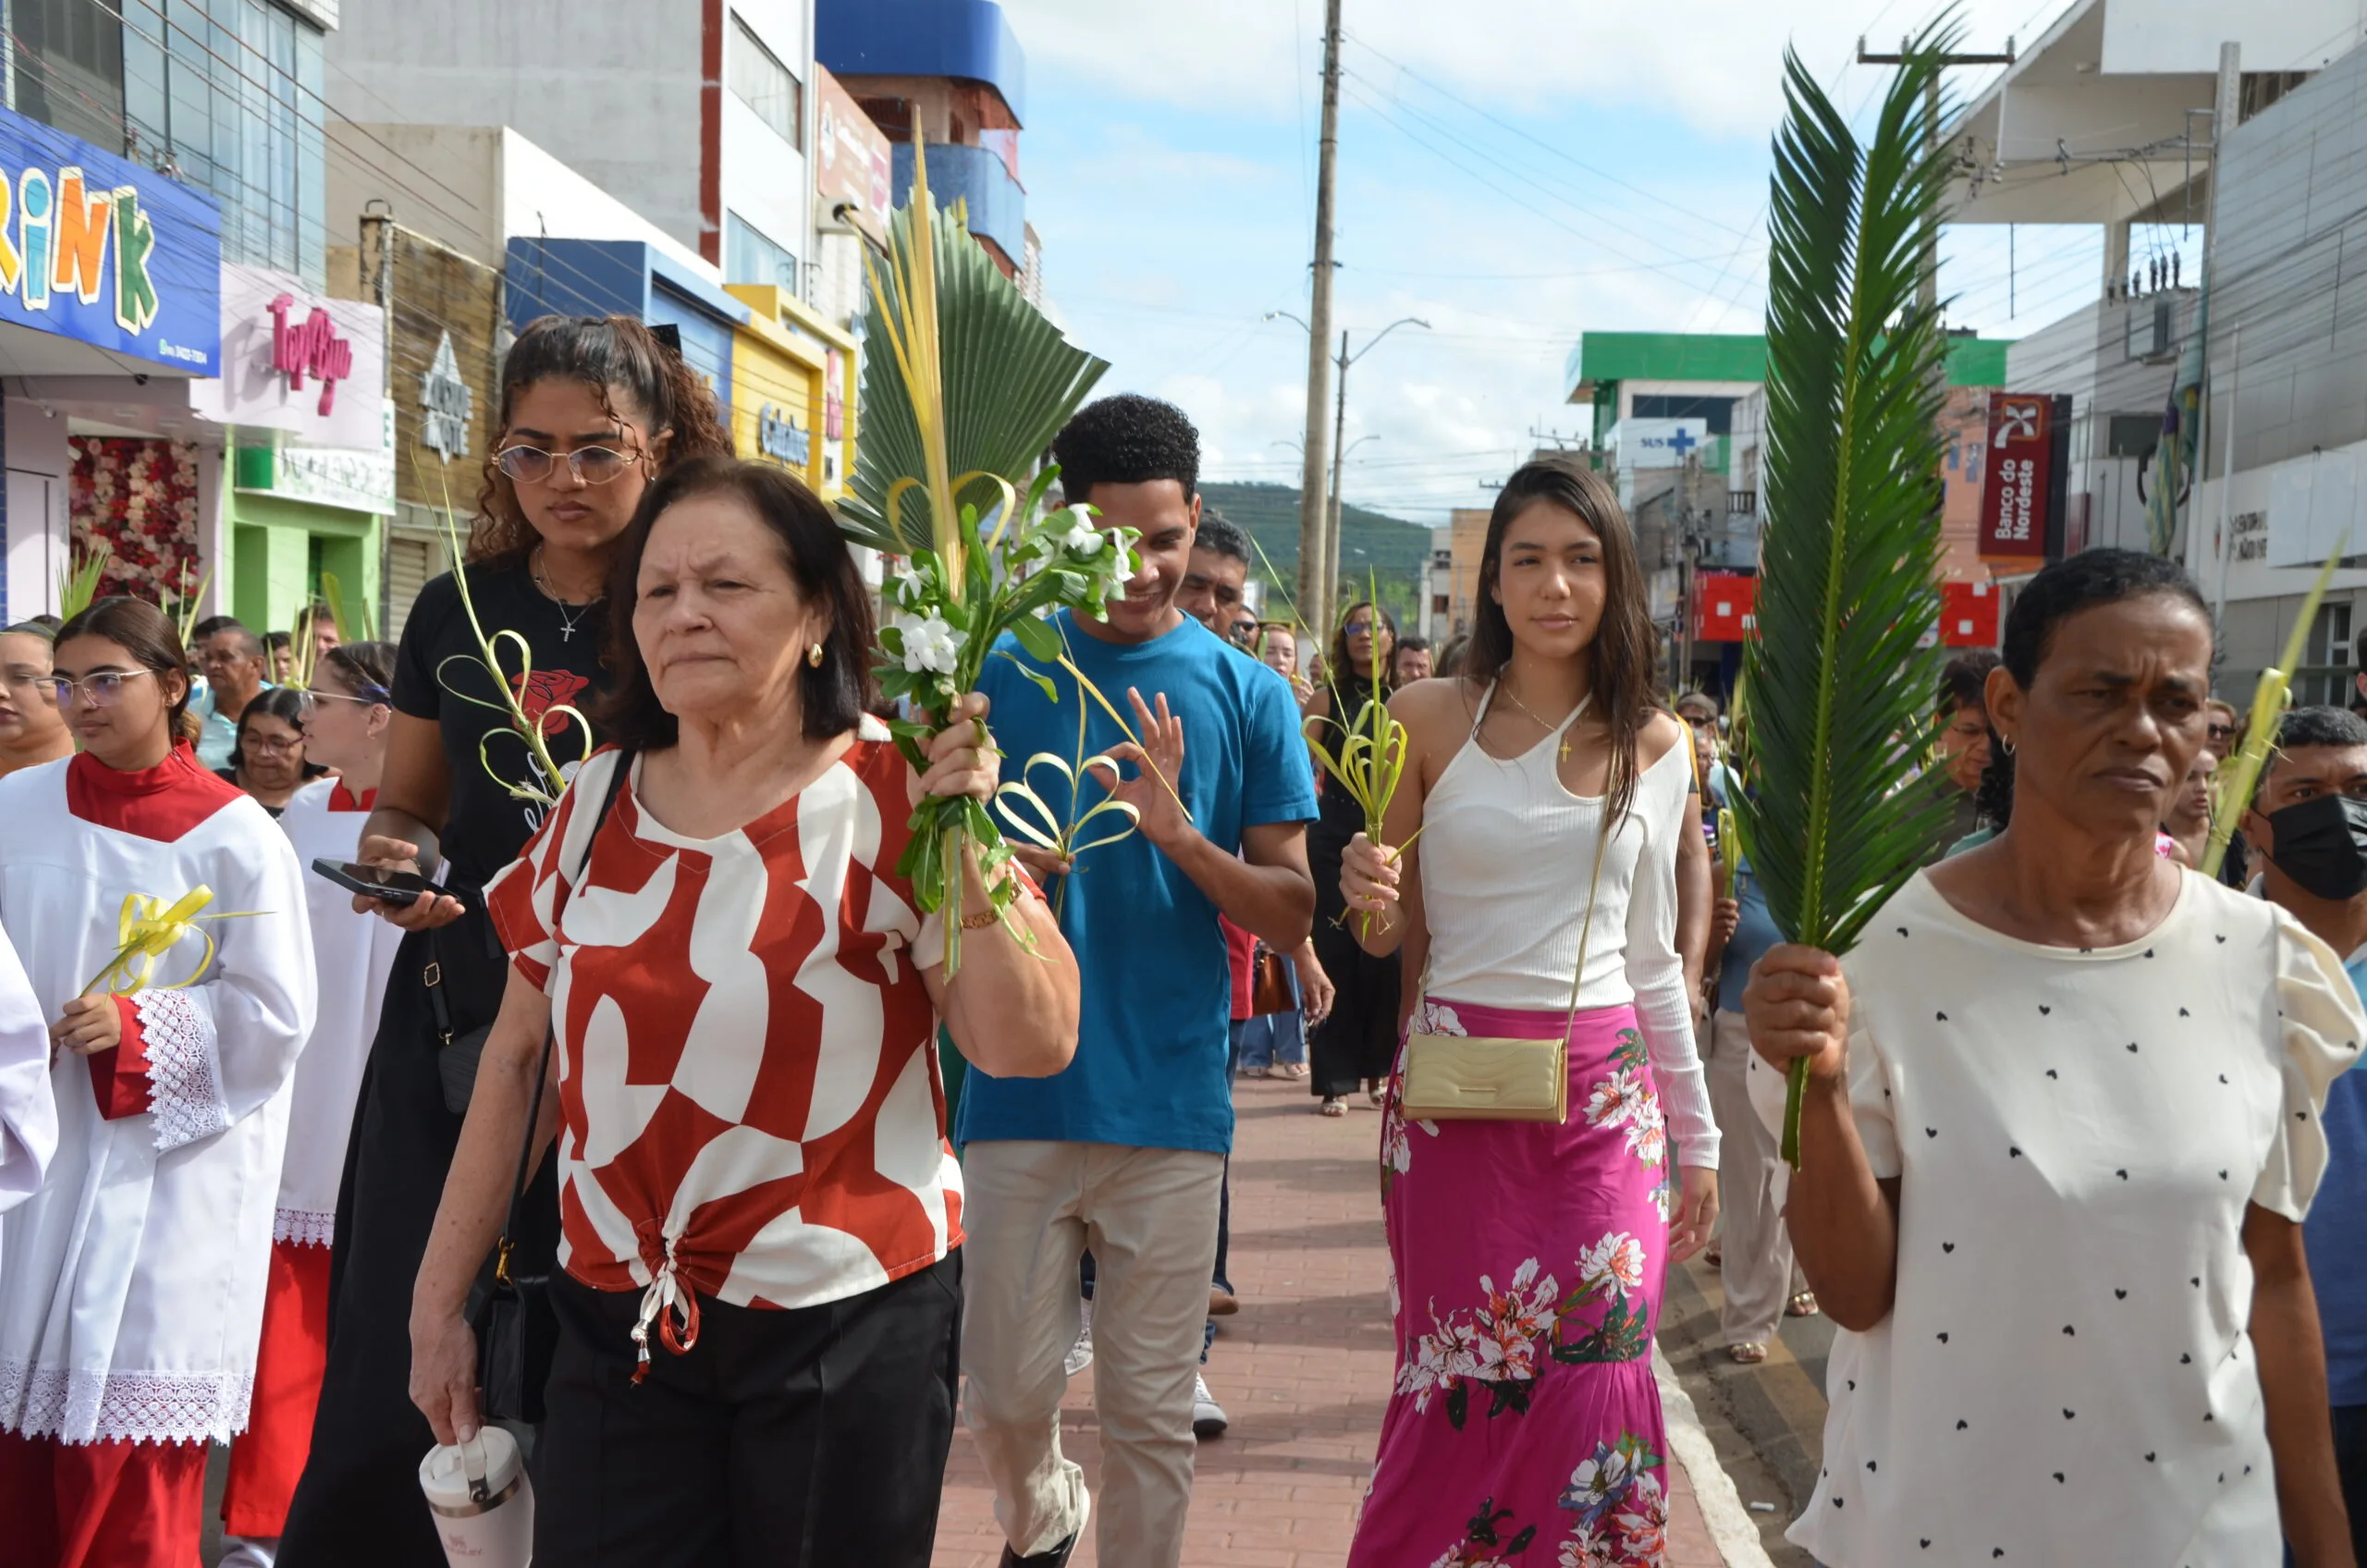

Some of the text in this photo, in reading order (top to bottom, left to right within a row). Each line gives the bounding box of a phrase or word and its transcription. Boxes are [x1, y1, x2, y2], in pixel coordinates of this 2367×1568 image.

[1994, 459, 2017, 540] Banco do
[2012, 459, 2034, 541] Nordeste
